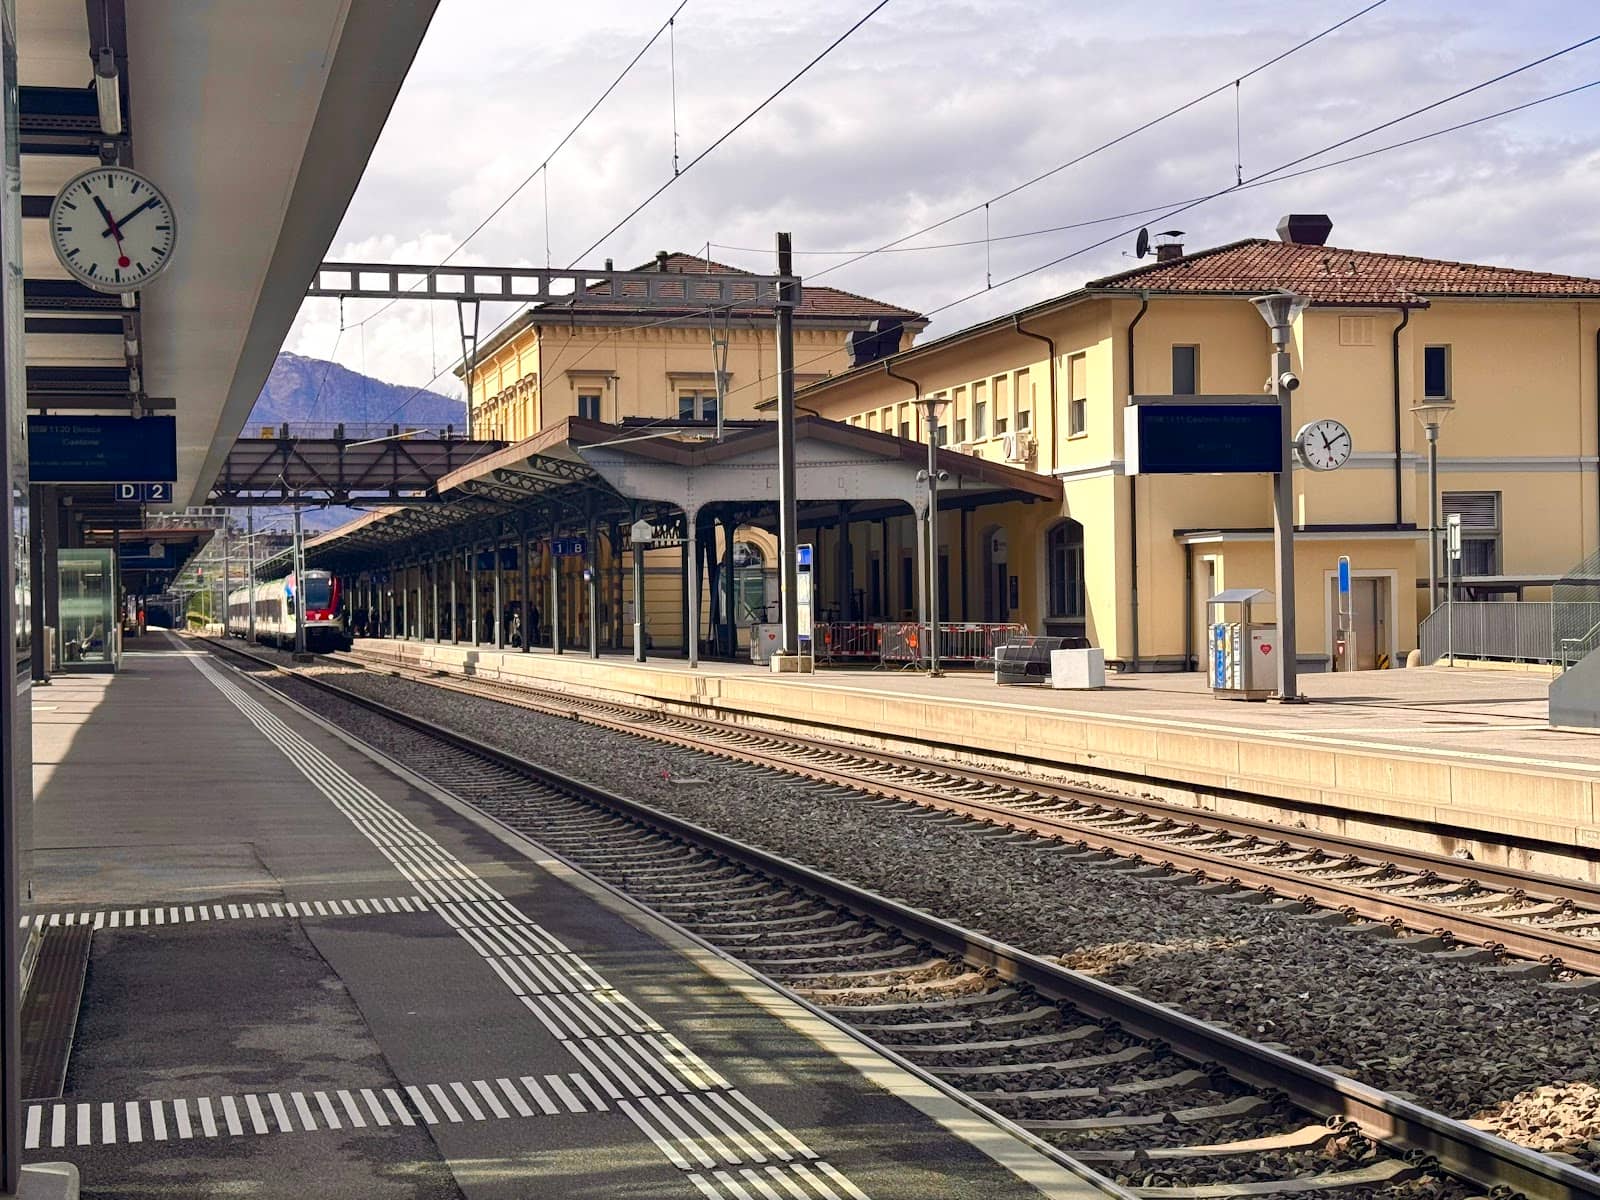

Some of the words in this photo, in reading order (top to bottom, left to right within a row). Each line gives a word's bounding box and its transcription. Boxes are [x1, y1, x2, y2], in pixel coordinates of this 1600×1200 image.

[121, 484, 135, 499] D
[151, 484, 164, 499] 2
[557, 543, 562, 553] 1
[574, 543, 583, 553] B
